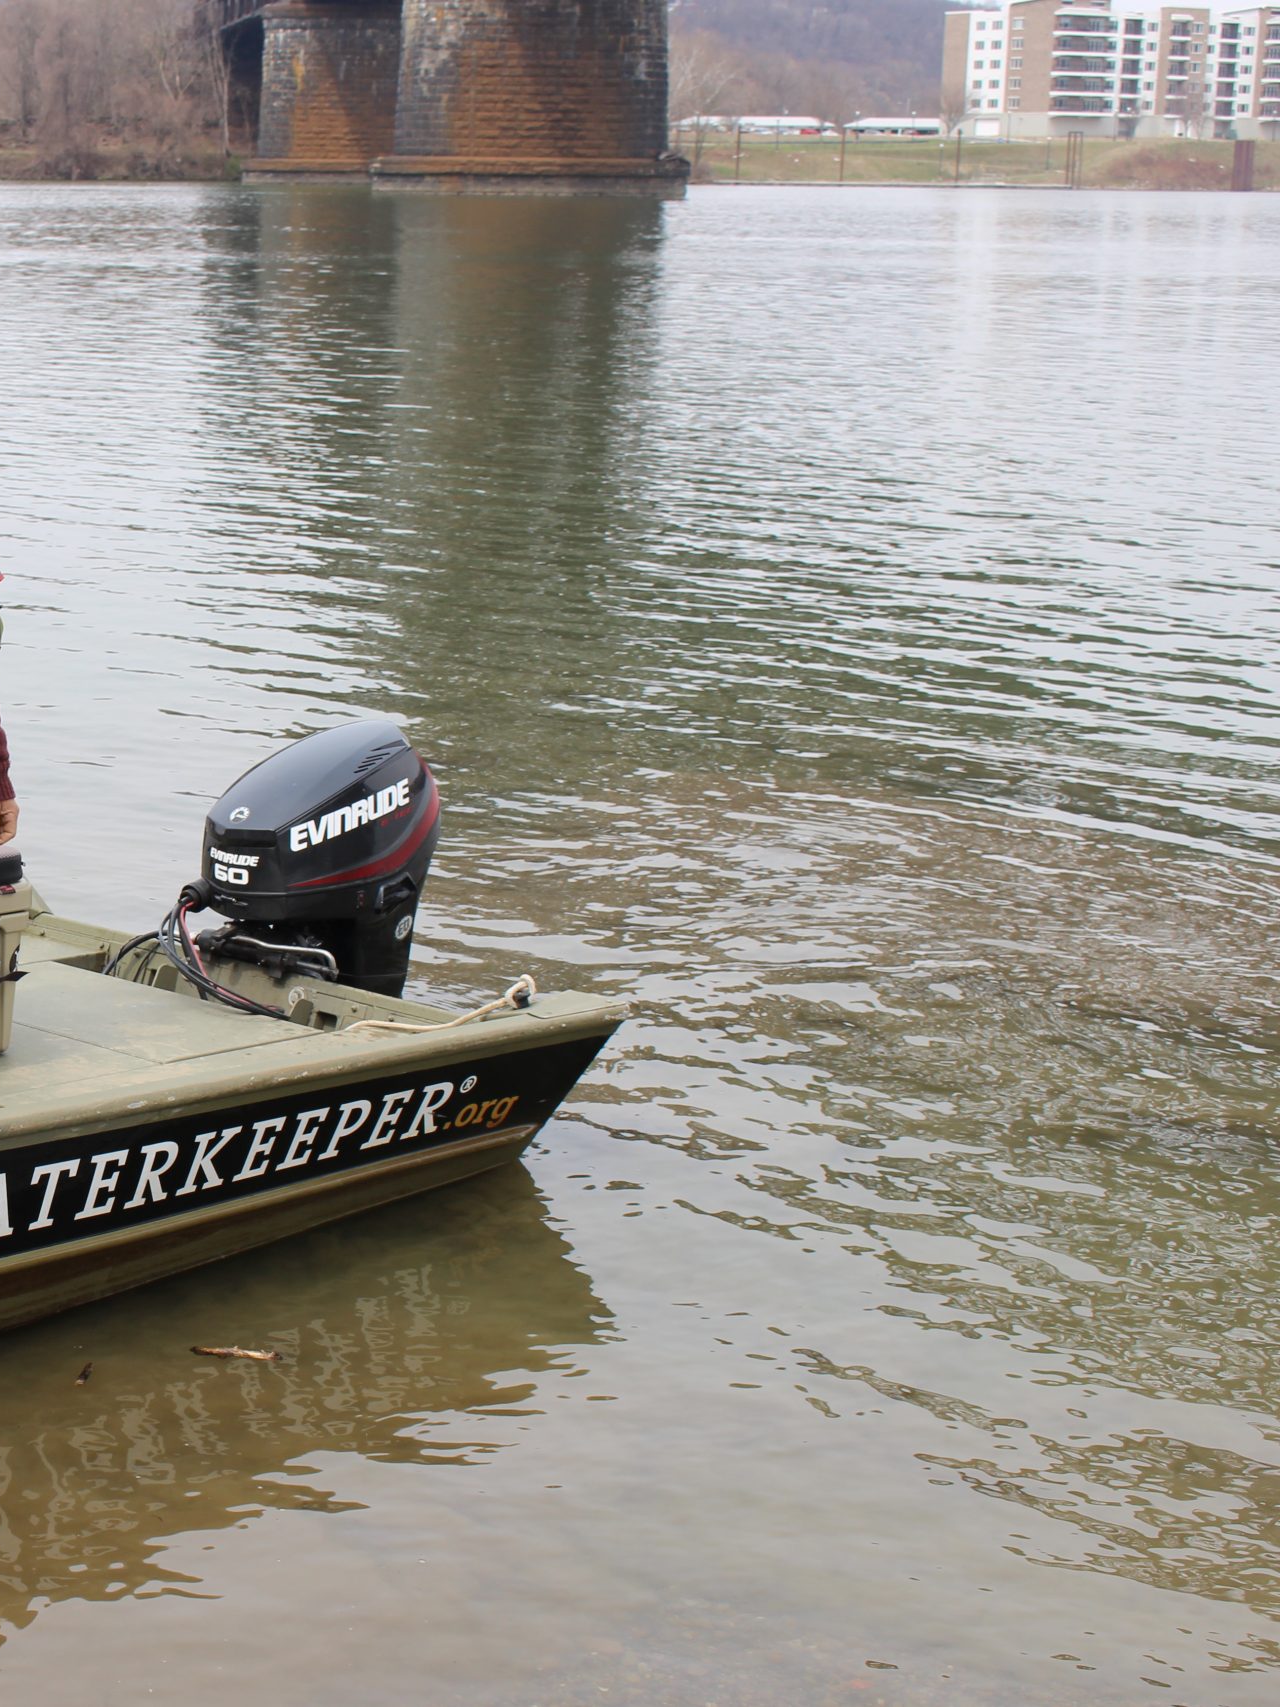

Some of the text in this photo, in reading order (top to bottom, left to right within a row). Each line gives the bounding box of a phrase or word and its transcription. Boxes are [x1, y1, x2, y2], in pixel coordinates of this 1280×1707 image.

[289, 777, 410, 853] EVINRUDE
[210, 846, 260, 868] EVINRUDE
[214, 862, 250, 886] 60
